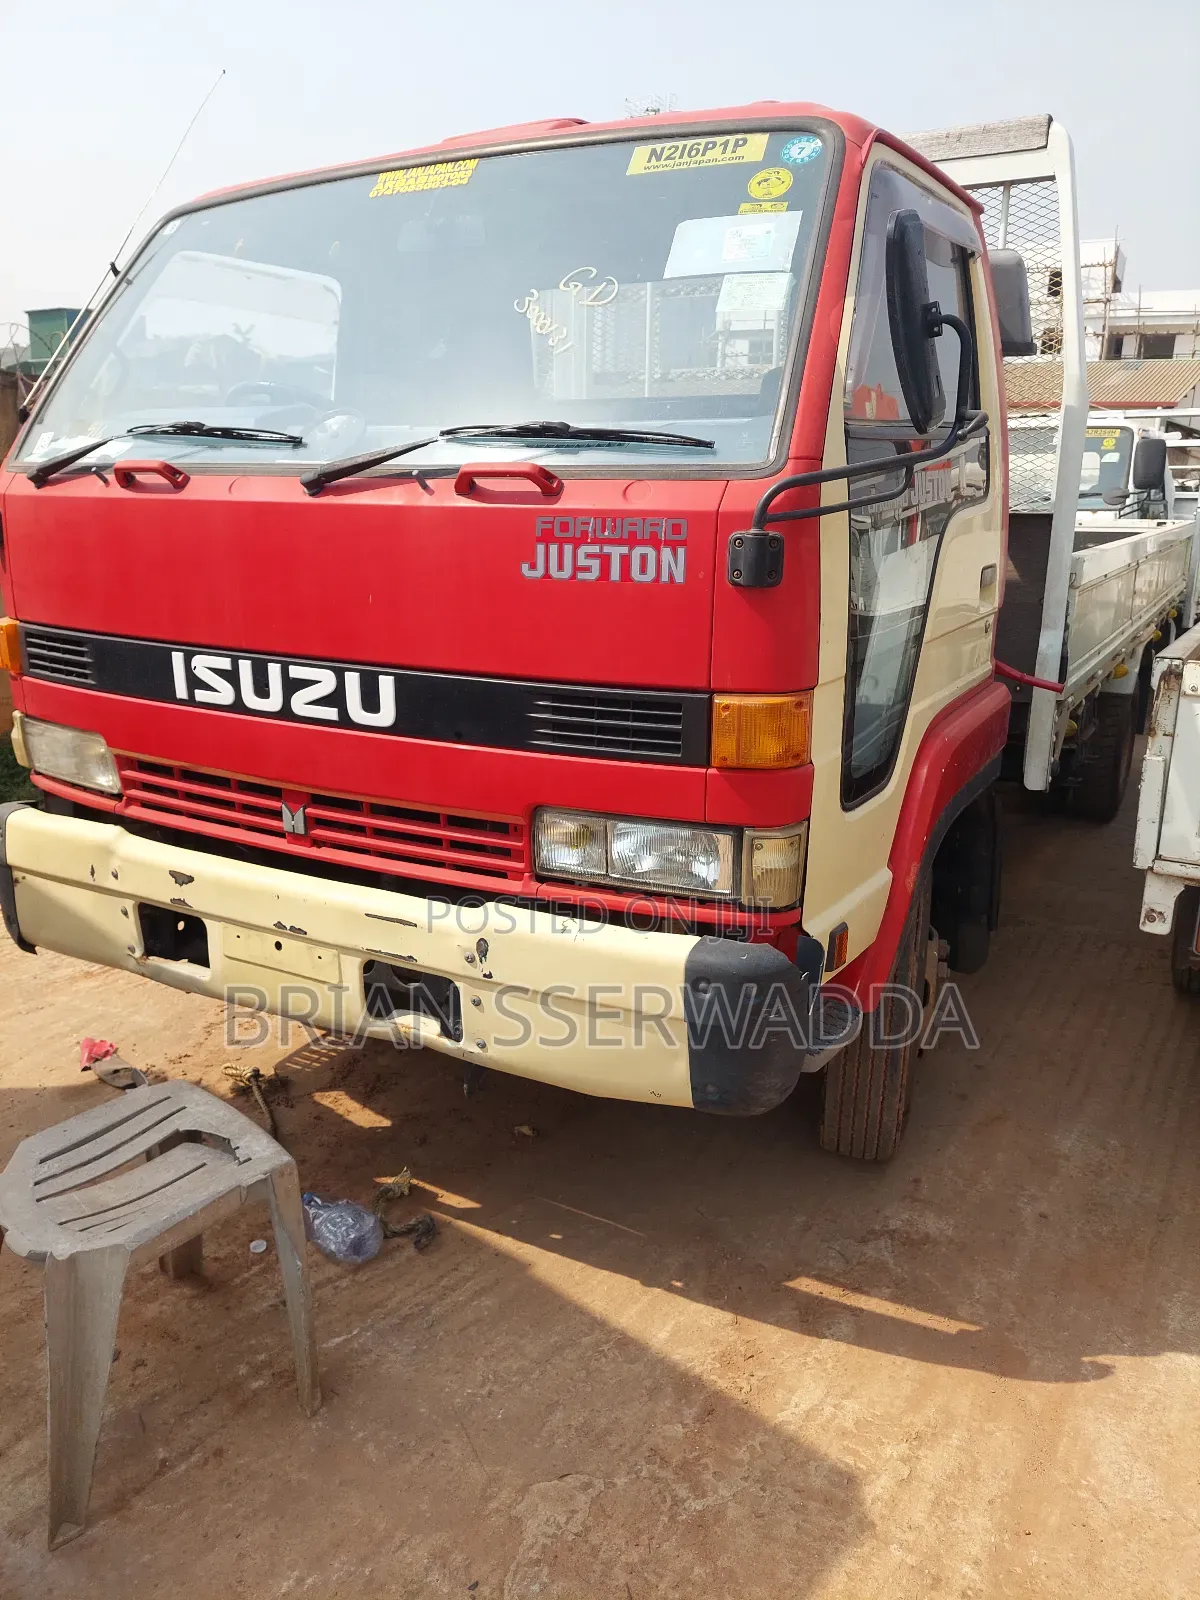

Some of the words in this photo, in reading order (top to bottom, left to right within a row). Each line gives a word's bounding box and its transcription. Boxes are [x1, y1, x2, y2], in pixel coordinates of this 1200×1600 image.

[643, 155, 745, 171] www.janjapan.com
[535, 516, 688, 541] FORWARD
[520, 542, 687, 584] JUSTON
[171, 651, 397, 728] ISUZU
